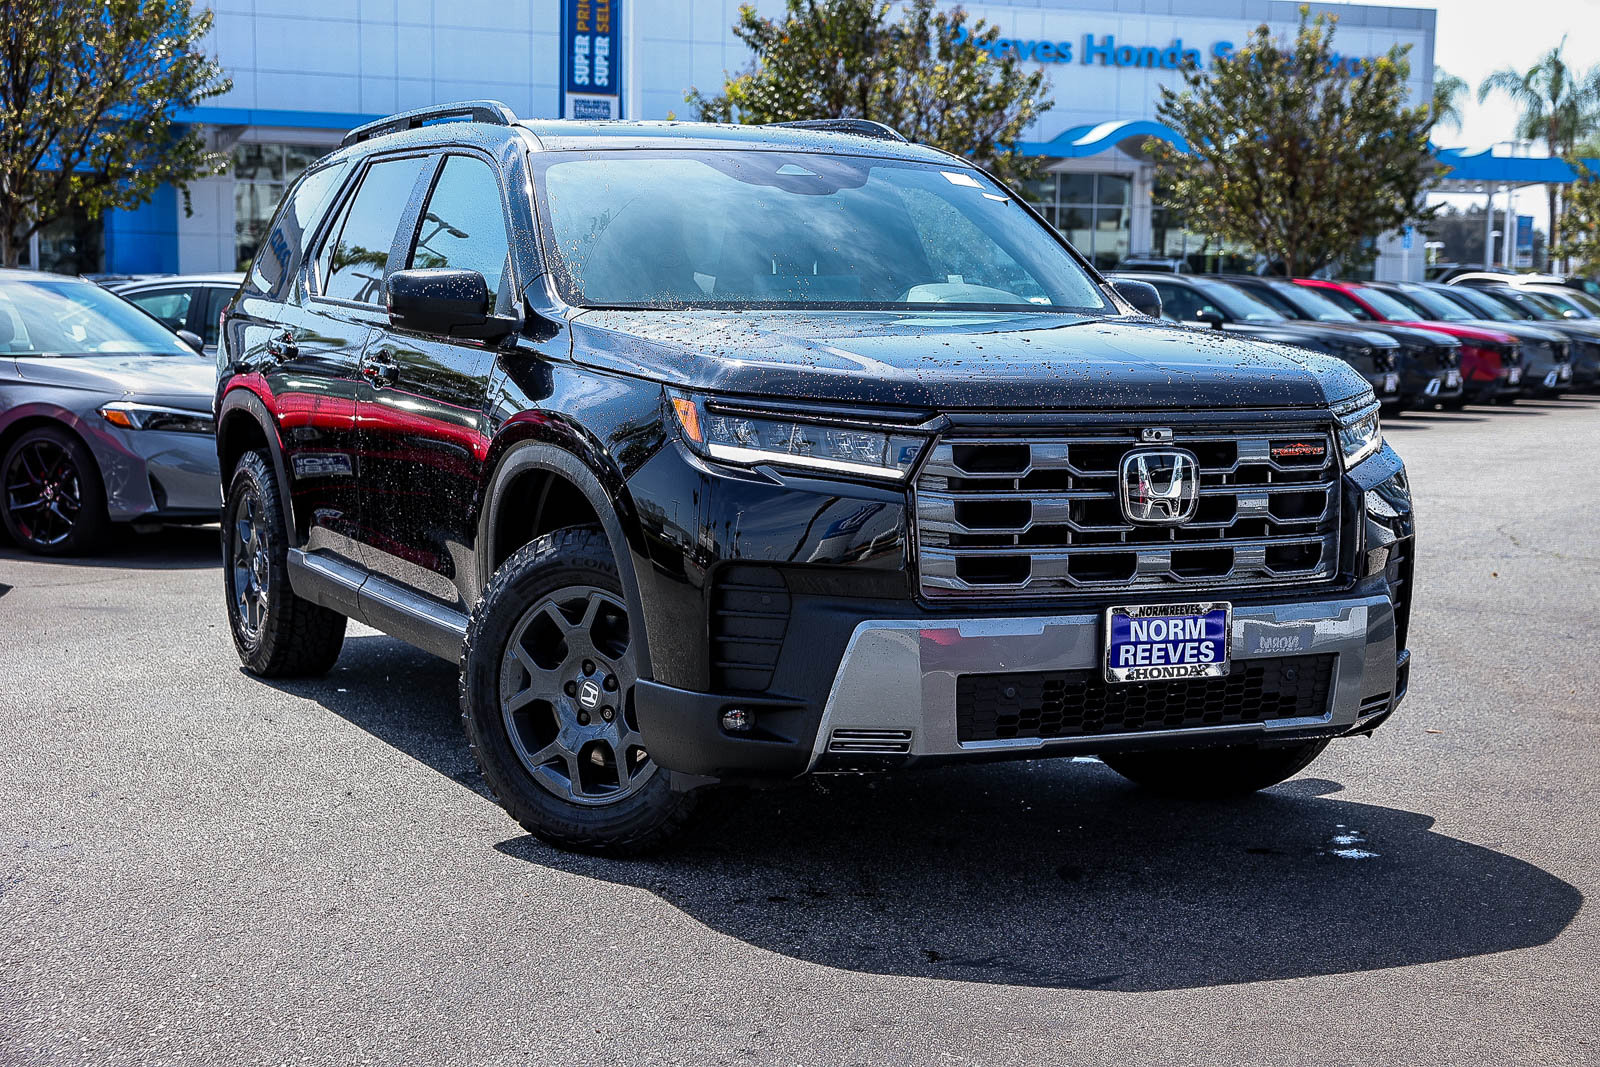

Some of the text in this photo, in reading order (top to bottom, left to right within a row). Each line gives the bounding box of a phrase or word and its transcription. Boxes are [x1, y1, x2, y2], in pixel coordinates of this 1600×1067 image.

[574, 0, 591, 86] SUPER PRI
[594, 0, 610, 87] SUPER SEL
[1083, 34, 1201, 69] Honda
[1130, 618, 1206, 642] NORM
[1119, 641, 1215, 666] REEVES
[1135, 665, 1201, 680] HONDA
